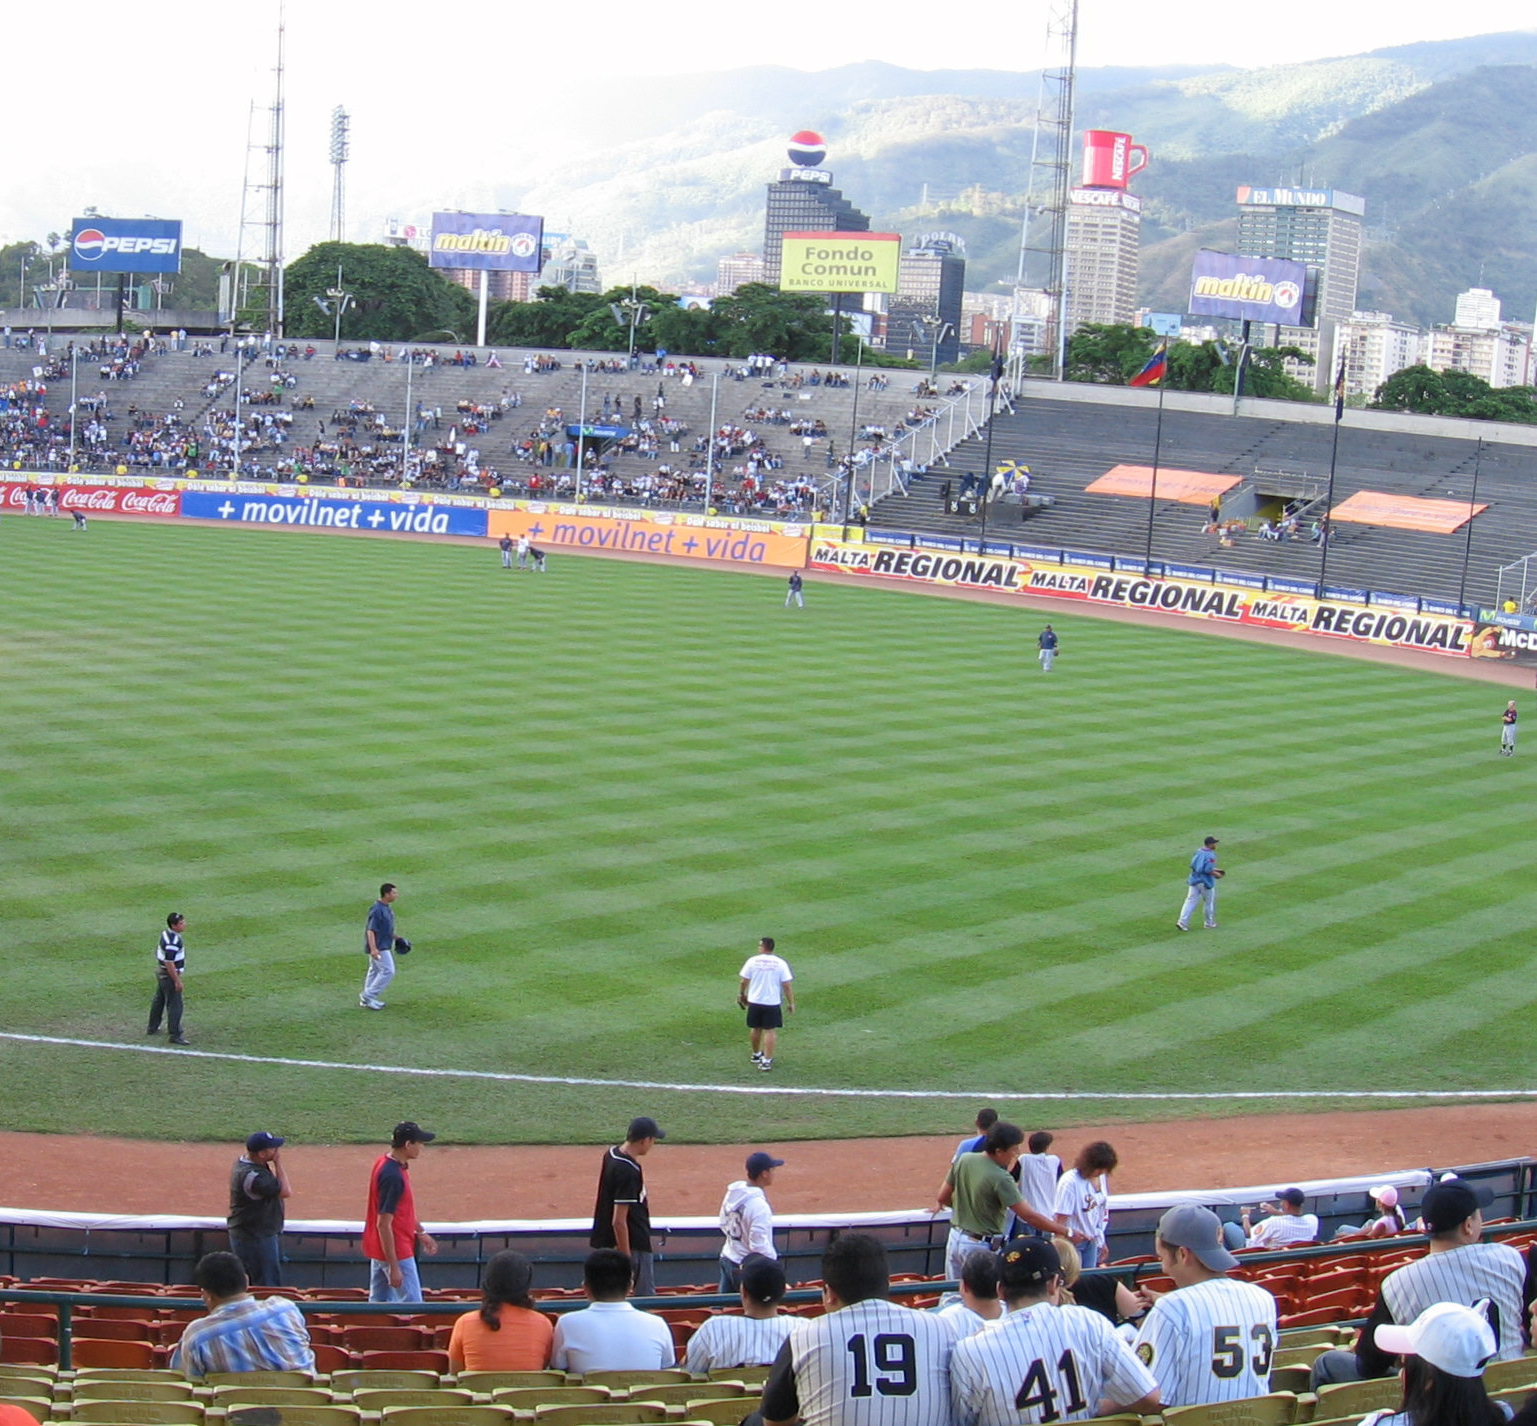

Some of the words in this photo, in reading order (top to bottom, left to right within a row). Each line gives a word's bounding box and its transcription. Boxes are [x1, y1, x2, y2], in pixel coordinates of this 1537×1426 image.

[1253, 190, 1271, 204] EL
[100, 236, 178, 254] PEPSI
[804, 246, 874, 262] Fondo
[788, 278, 825, 288] BANCO
[828, 279, 888, 289] UNIVERSAL
[801, 262, 877, 277] Comun
[1194, 273, 1275, 303] maltín
[241, 498, 362, 529] movilnet
[390, 505, 450, 534] vida
[552, 520, 675, 553] movilnet
[707, 532, 767, 563] vida
[814, 548, 870, 568] MALTA
[873, 550, 1020, 589] REGIONAL
[1030, 571, 1088, 592] MALTA
[1090, 576, 1242, 618] REGIONAL
[1251, 599, 1308, 623] MALTA
[1312, 606, 1470, 652] REGIONAL
[847, 1333, 918, 1398] 19
[1211, 1323, 1274, 1380] 53
[1015, 1348, 1088, 1425] 41
